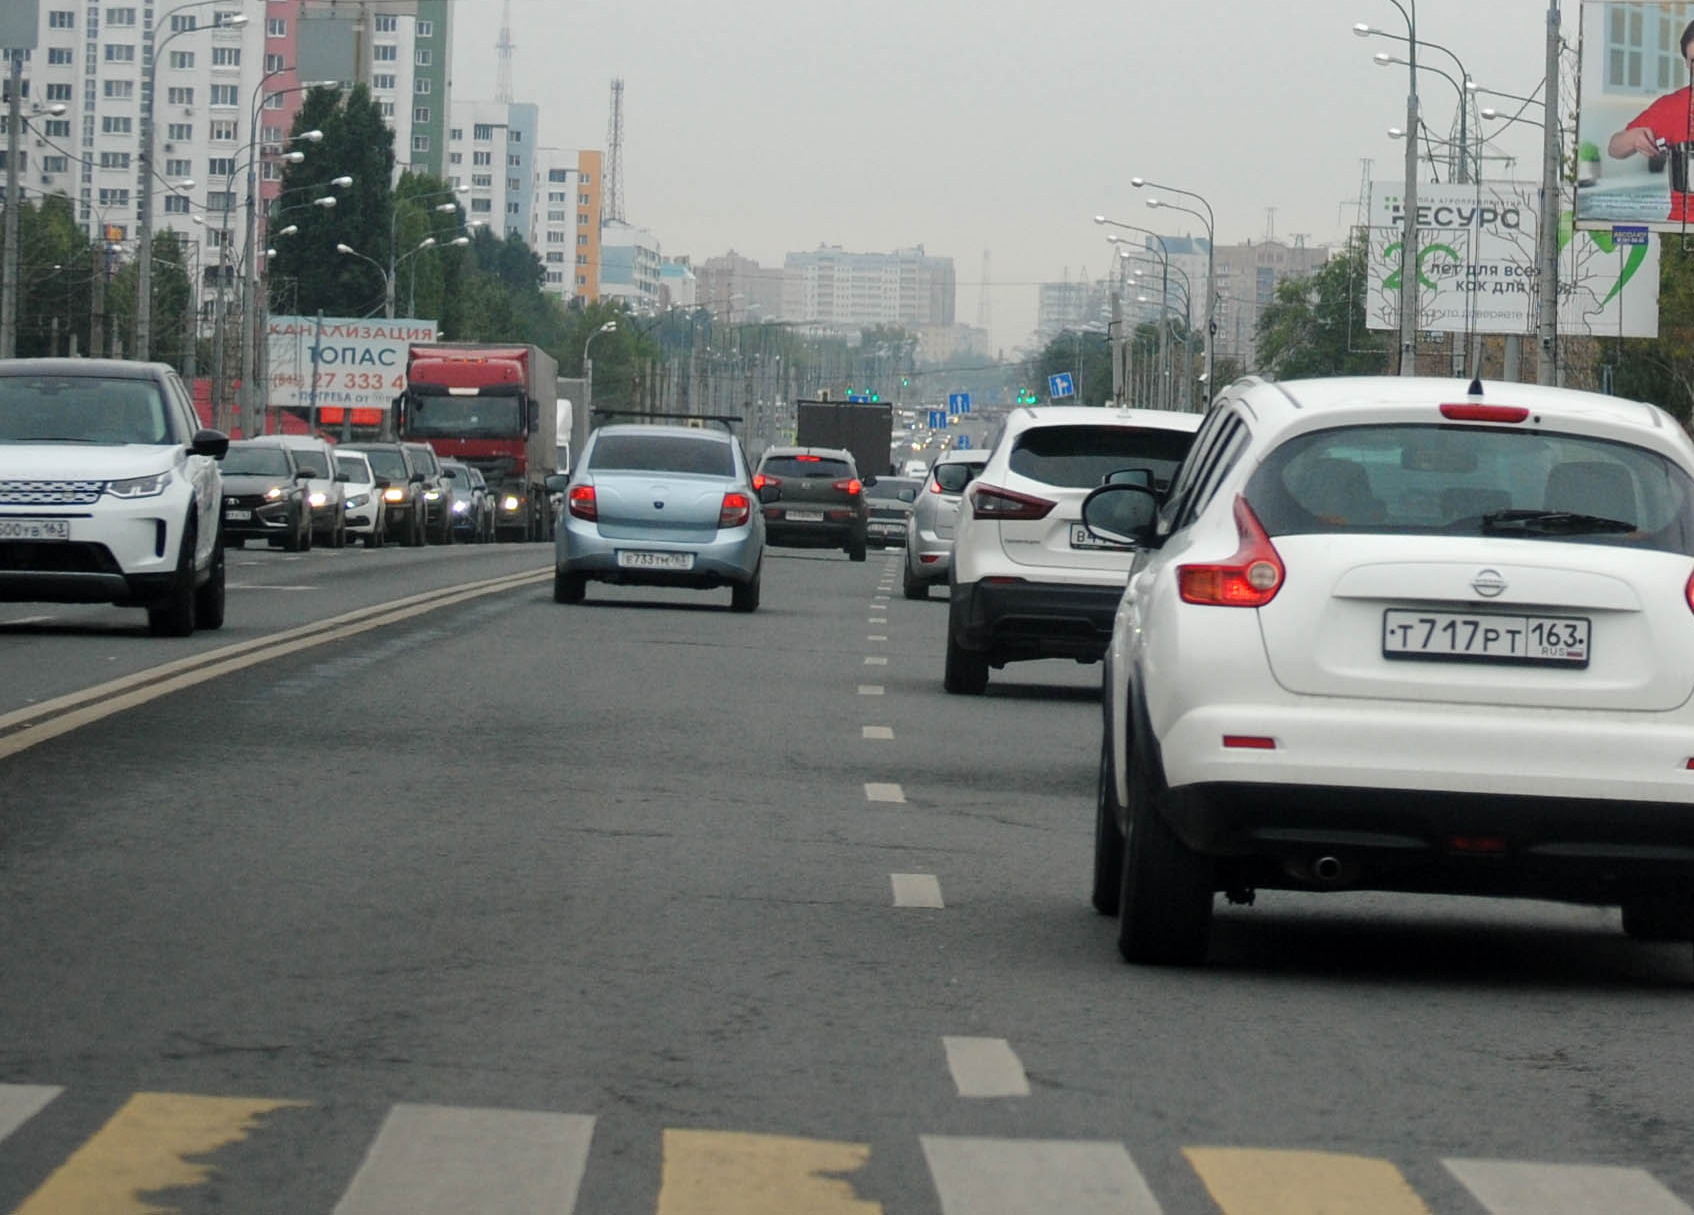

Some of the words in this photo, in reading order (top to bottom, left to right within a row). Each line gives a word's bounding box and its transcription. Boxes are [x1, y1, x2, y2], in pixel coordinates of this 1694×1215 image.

[1431, 263, 1461, 275] лет
[1466, 265, 1499, 278] для
[1455, 280, 1487, 293] как
[269, 323, 433, 341] КАНАЛИЗАЦИЯ
[308, 346, 396, 366] ТОПАС
[344, 373, 383, 390] 333
[1397, 618, 1522, 653] Т717РТ
[1531, 623, 1578, 647] 163
[1541, 646, 1566, 656] RUS
